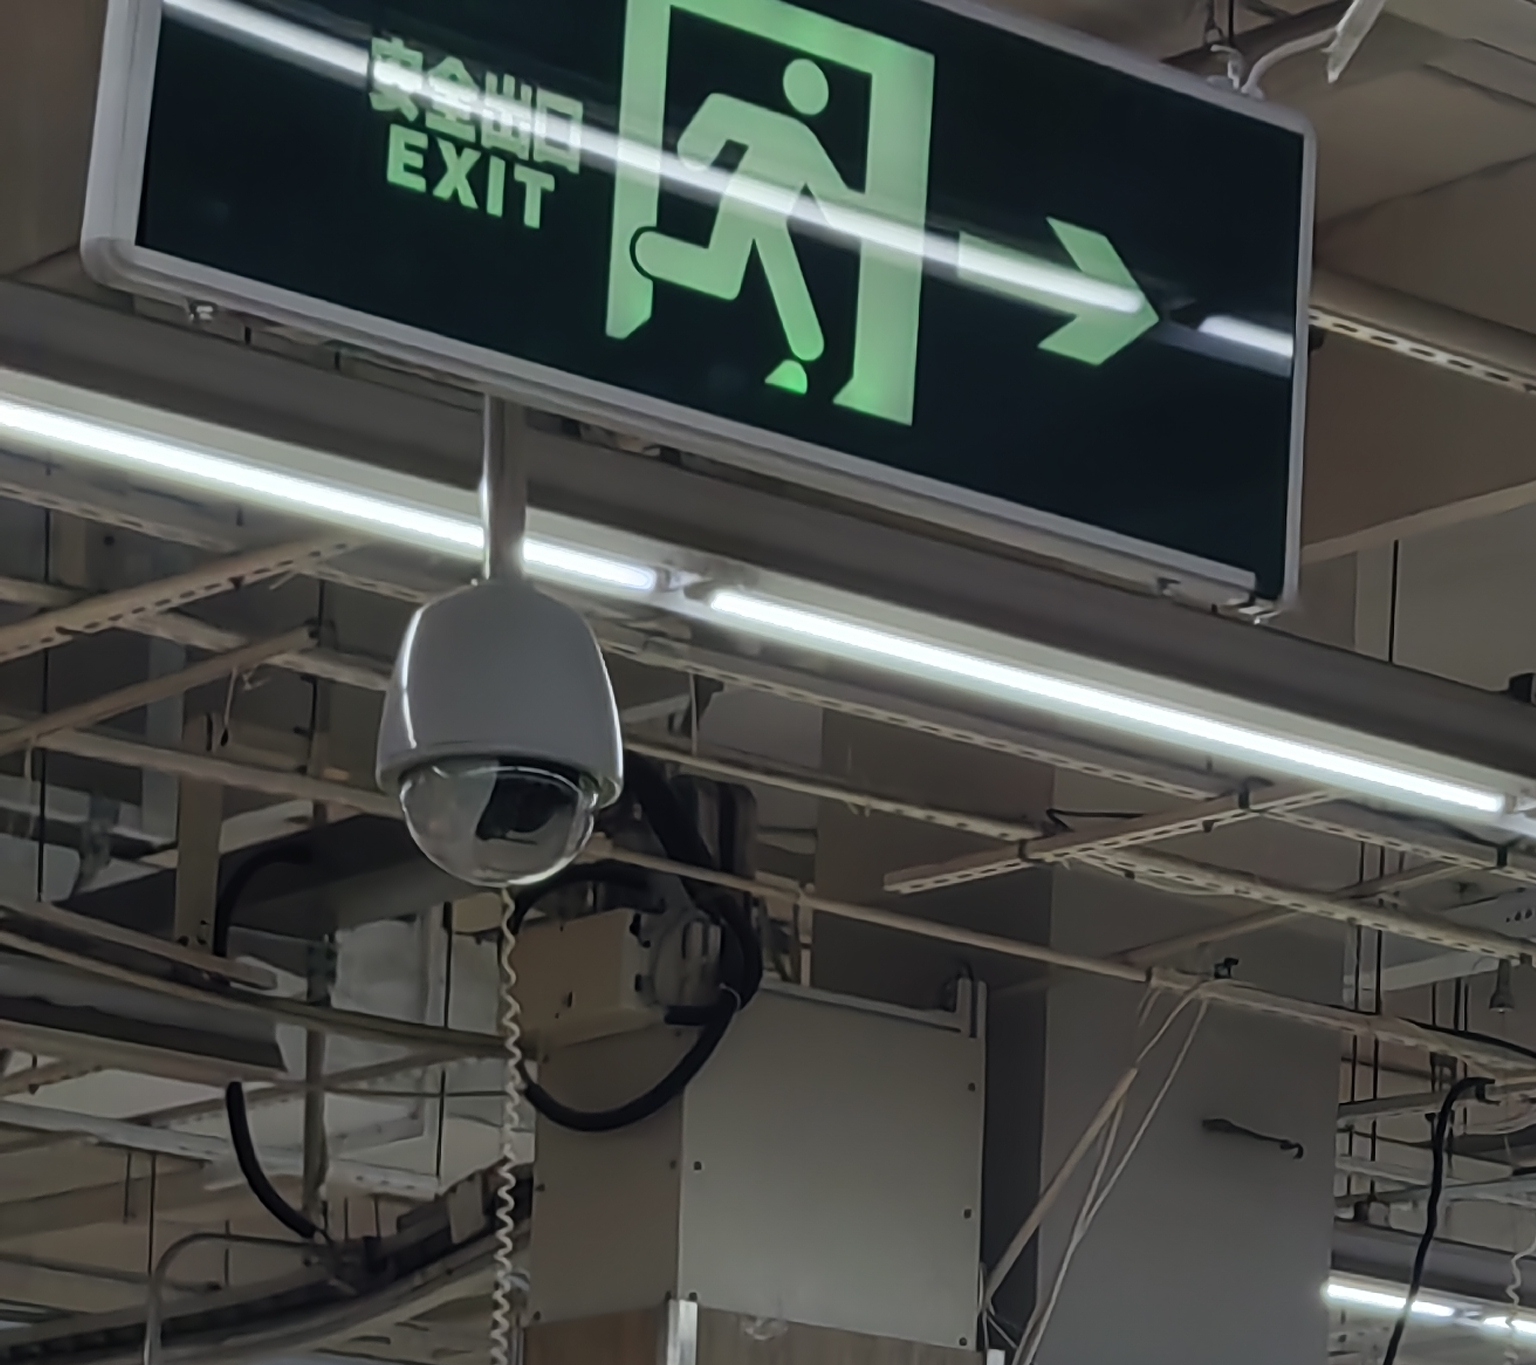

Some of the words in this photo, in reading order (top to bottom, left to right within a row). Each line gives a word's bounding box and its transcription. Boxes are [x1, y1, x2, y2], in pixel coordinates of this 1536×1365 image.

[369, 30, 583, 174] 安全出口
[387, 123, 555, 229] EXIT
